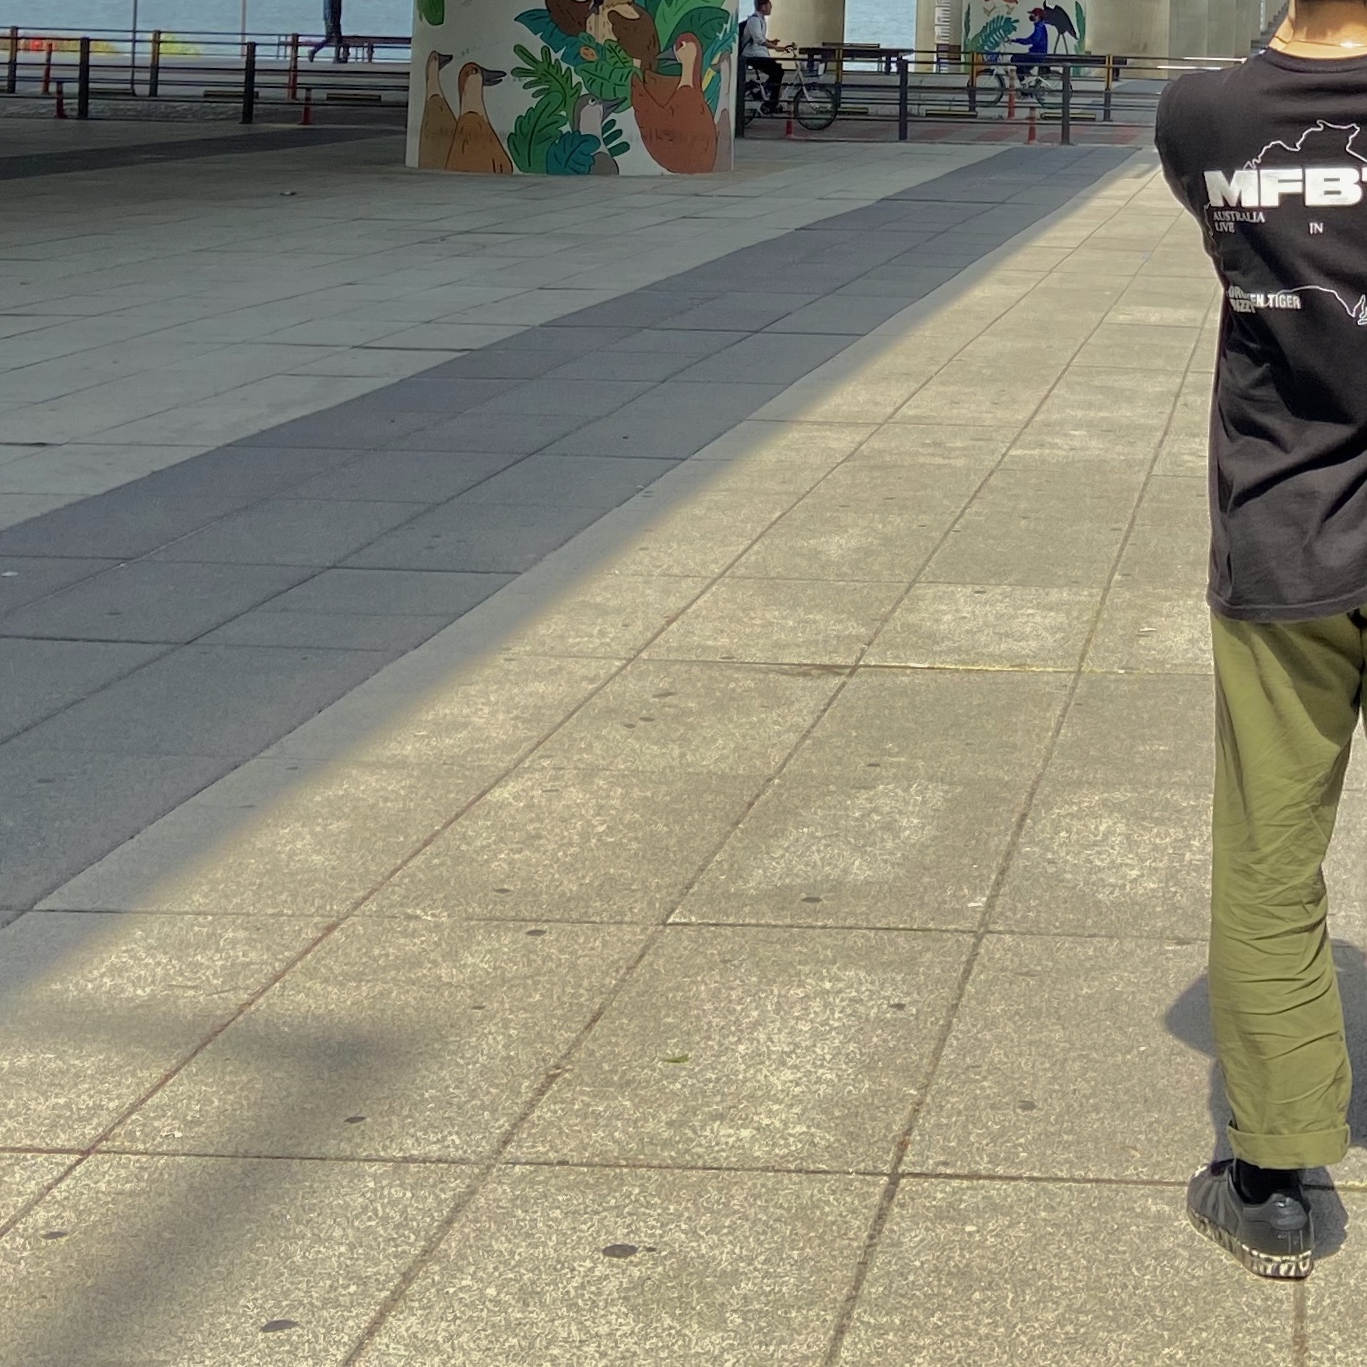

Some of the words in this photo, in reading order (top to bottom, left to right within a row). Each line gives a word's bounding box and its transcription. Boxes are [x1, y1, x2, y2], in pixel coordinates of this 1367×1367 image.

[1213, 211, 1265, 223] AUSTRALIA
[1214, 222, 1236, 233] LIVE
[1308, 222, 1324, 235] IN
[1267, 293, 1301, 309] TIGER
